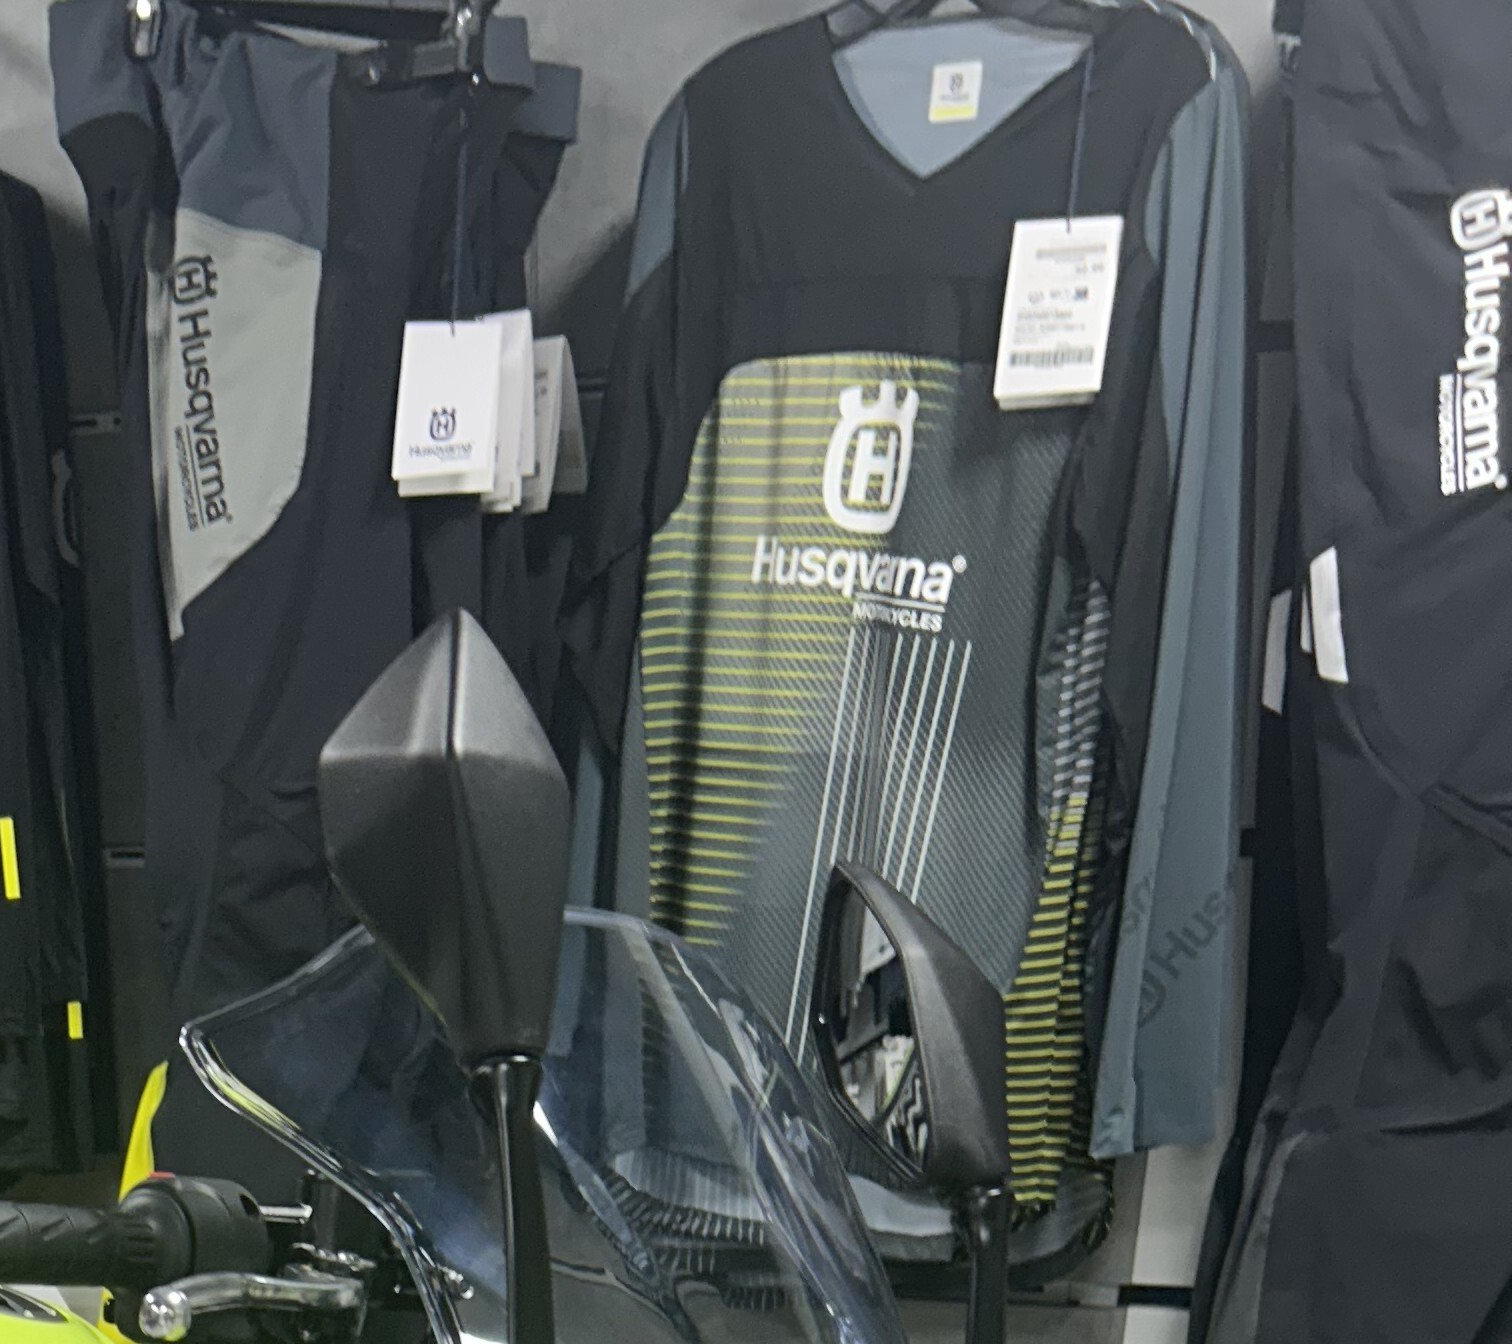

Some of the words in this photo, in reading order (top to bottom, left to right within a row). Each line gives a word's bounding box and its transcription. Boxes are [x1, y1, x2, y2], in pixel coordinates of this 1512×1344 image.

[177, 308, 229, 523] Husqvarna
[1455, 242, 1510, 491] Husqvarna
[175, 425, 200, 532] MOTORCYCLES
[750, 535, 954, 605] Husqvana
